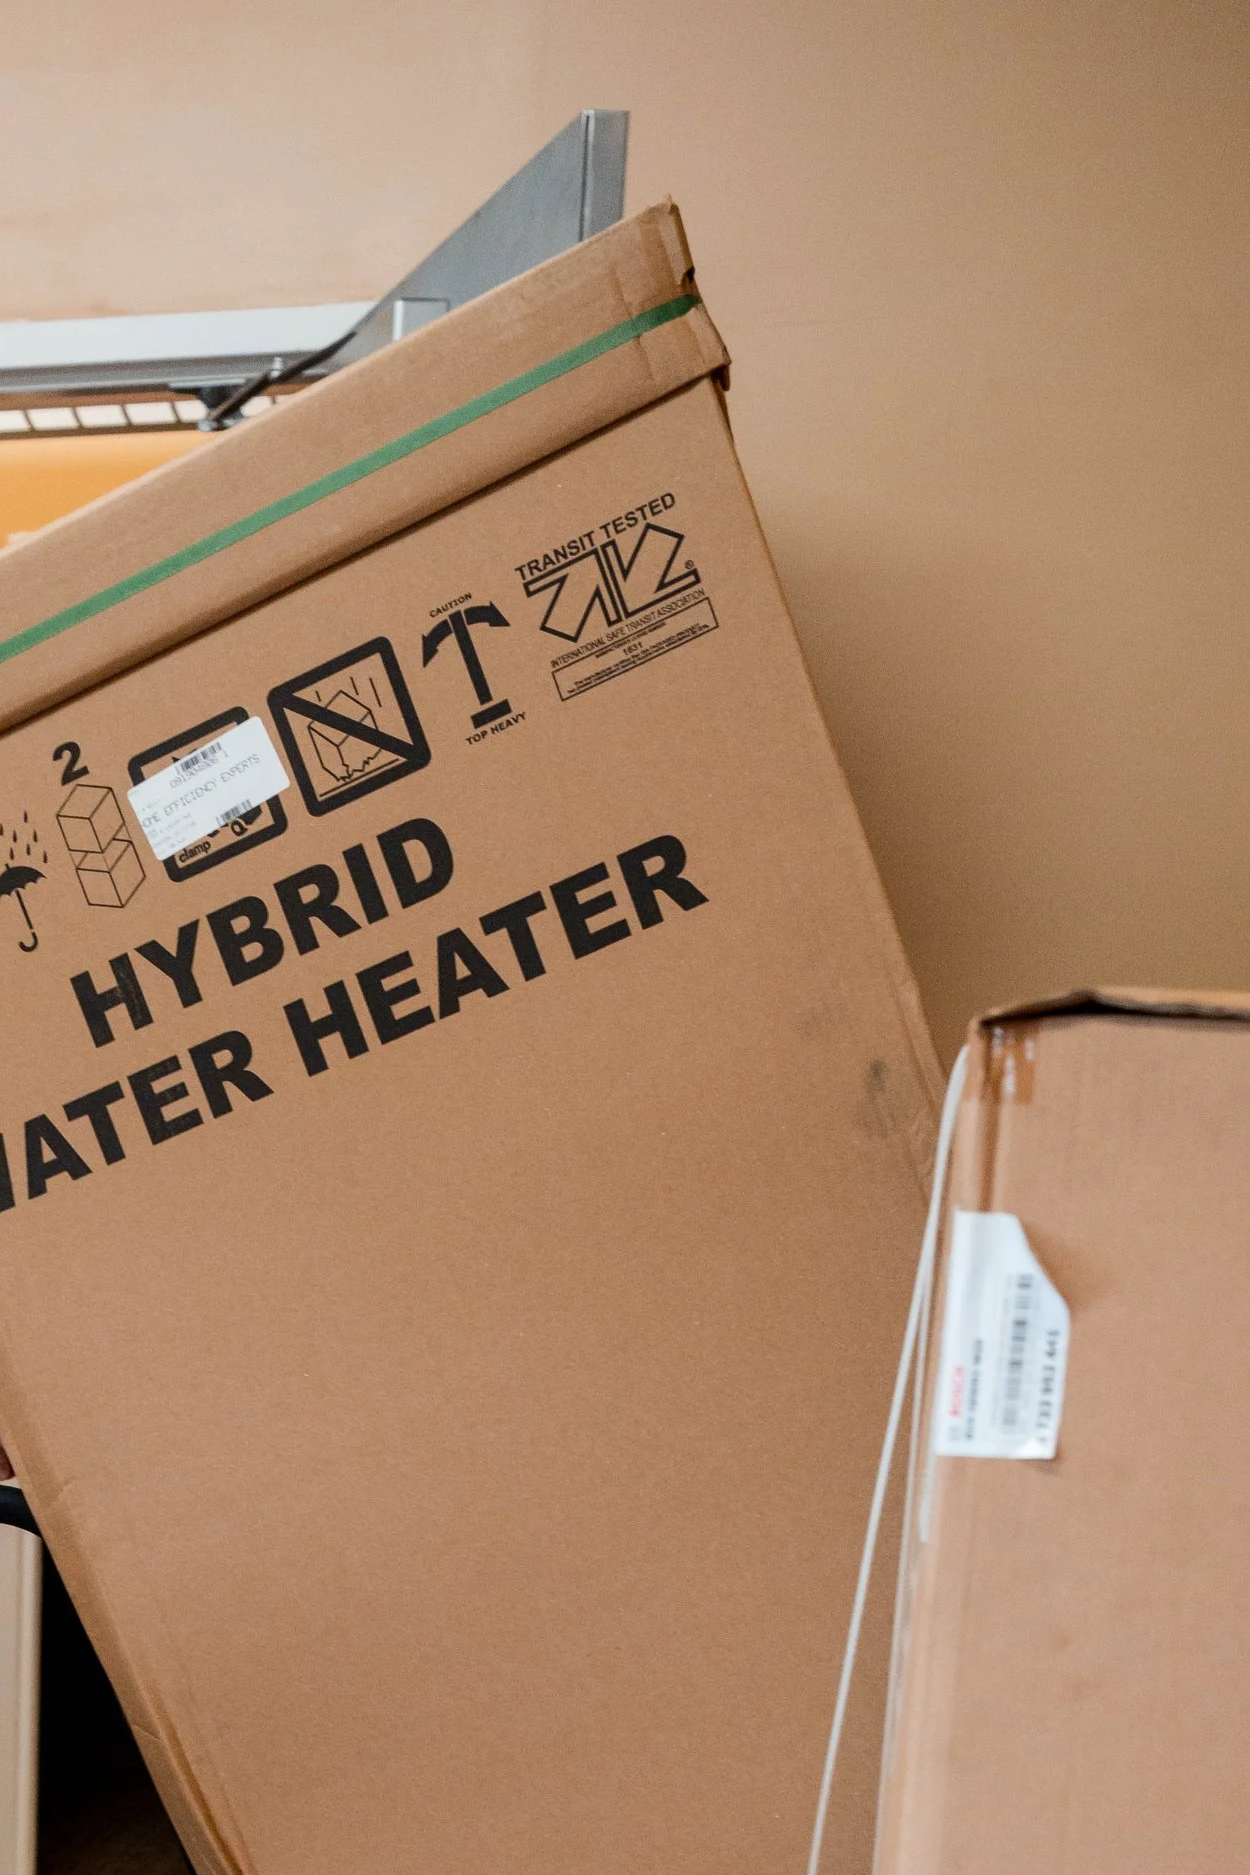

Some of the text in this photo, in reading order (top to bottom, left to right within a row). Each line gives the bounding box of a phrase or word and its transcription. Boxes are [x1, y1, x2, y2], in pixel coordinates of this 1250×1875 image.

[515, 492, 676, 581] TRANSIT TESTED
[429, 592, 472, 618] CAUTION
[550, 638, 606, 669] INTERNATIONAL
[606, 628, 627, 642] SAFE
[626, 614, 656, 633] TRANSIT
[655, 588, 706, 620] ASSOCIATION
[465, 712, 526, 745] TOP HEAVY
[52, 740, 89, 786] 2
[164, 778, 217, 817] EFFICIENCY
[178, 840, 212, 863] clamp
[69, 817, 454, 1048] HYBRID
[282, 834, 709, 1077] HEATER
